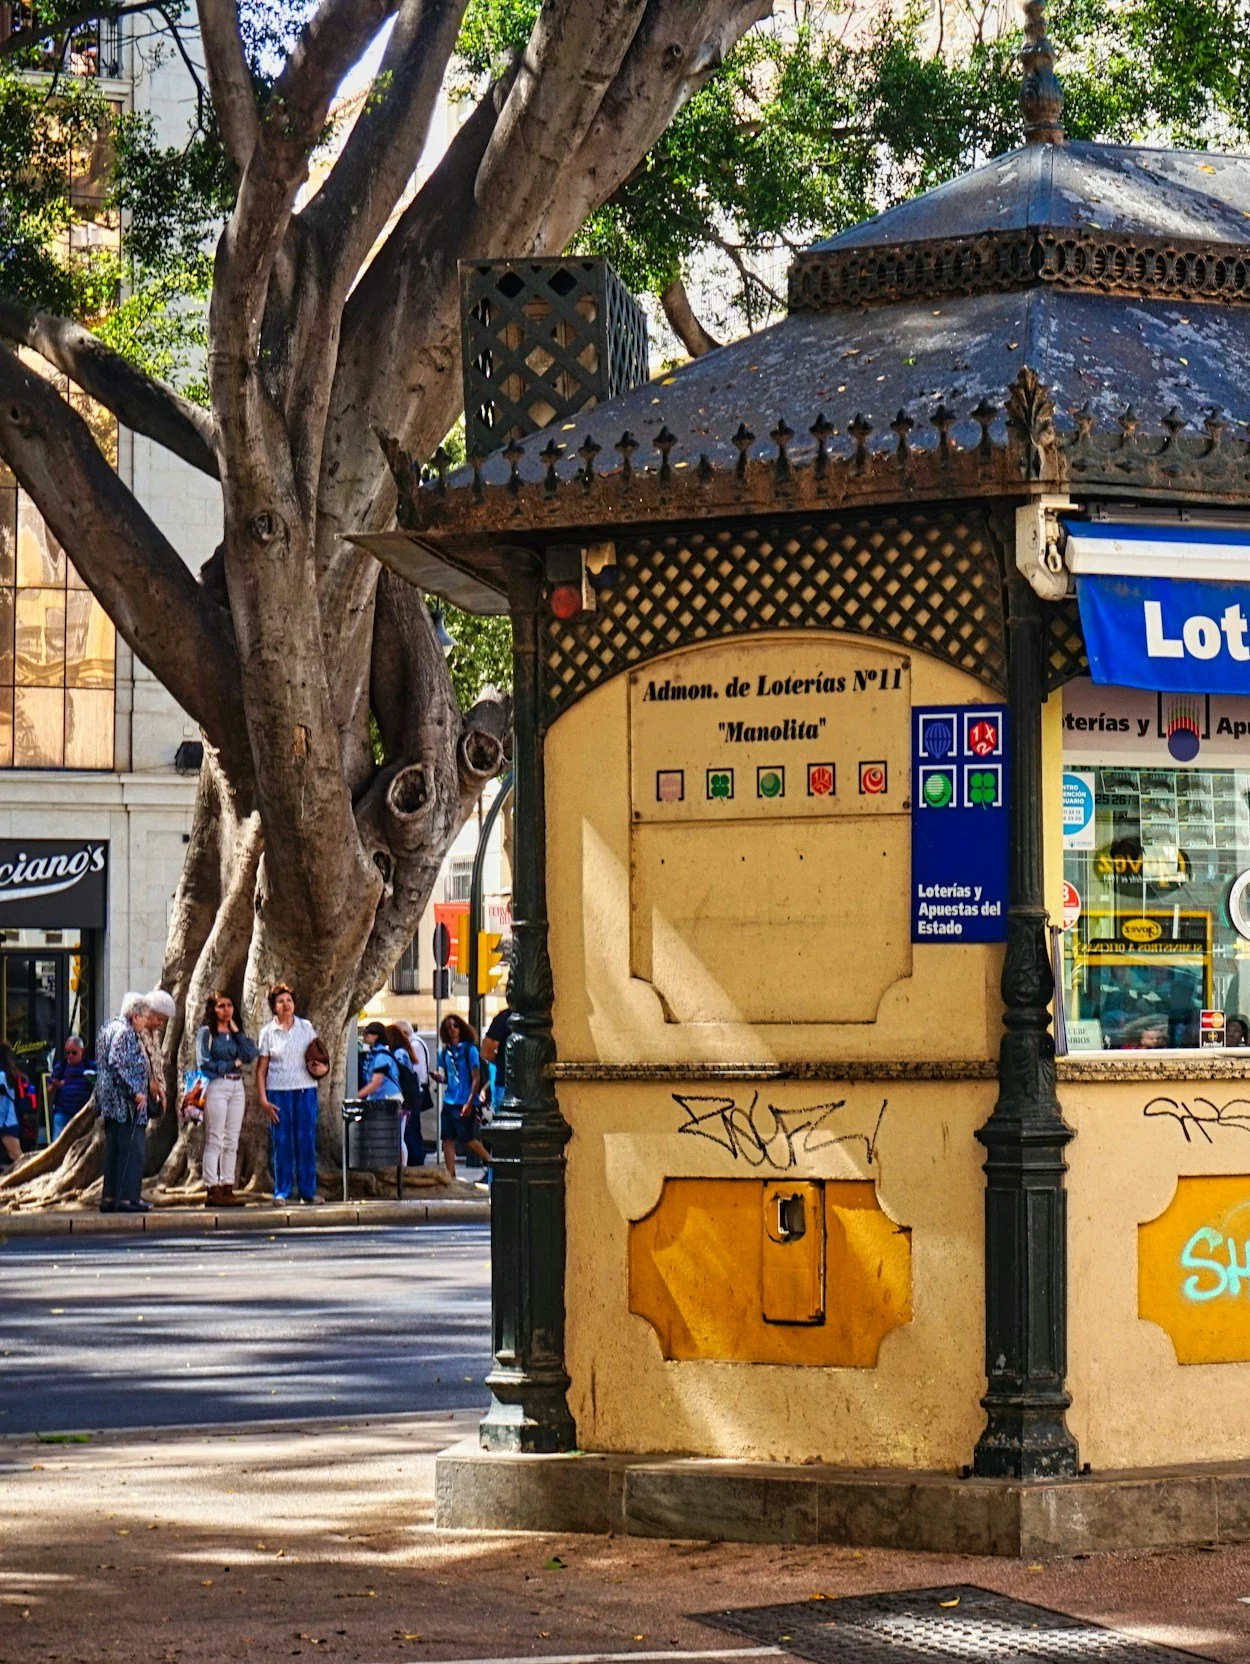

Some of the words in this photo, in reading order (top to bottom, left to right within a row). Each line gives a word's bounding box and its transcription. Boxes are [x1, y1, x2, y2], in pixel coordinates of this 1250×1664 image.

[643, 679, 719, 702] Admon.
[725, 676, 751, 698] de
[756, 669, 846, 697] Loterías
[718, 717, 827, 743] "Manolita"
[1062, 712, 1130, 731] terías
[1137, 718, 1150, 738] y
[918, 884, 971, 899] Loterías
[974, 886, 982, 901] y
[918, 901, 979, 919] Apuestas
[981, 900, 1001, 917] del
[918, 920, 963, 935] Estado
